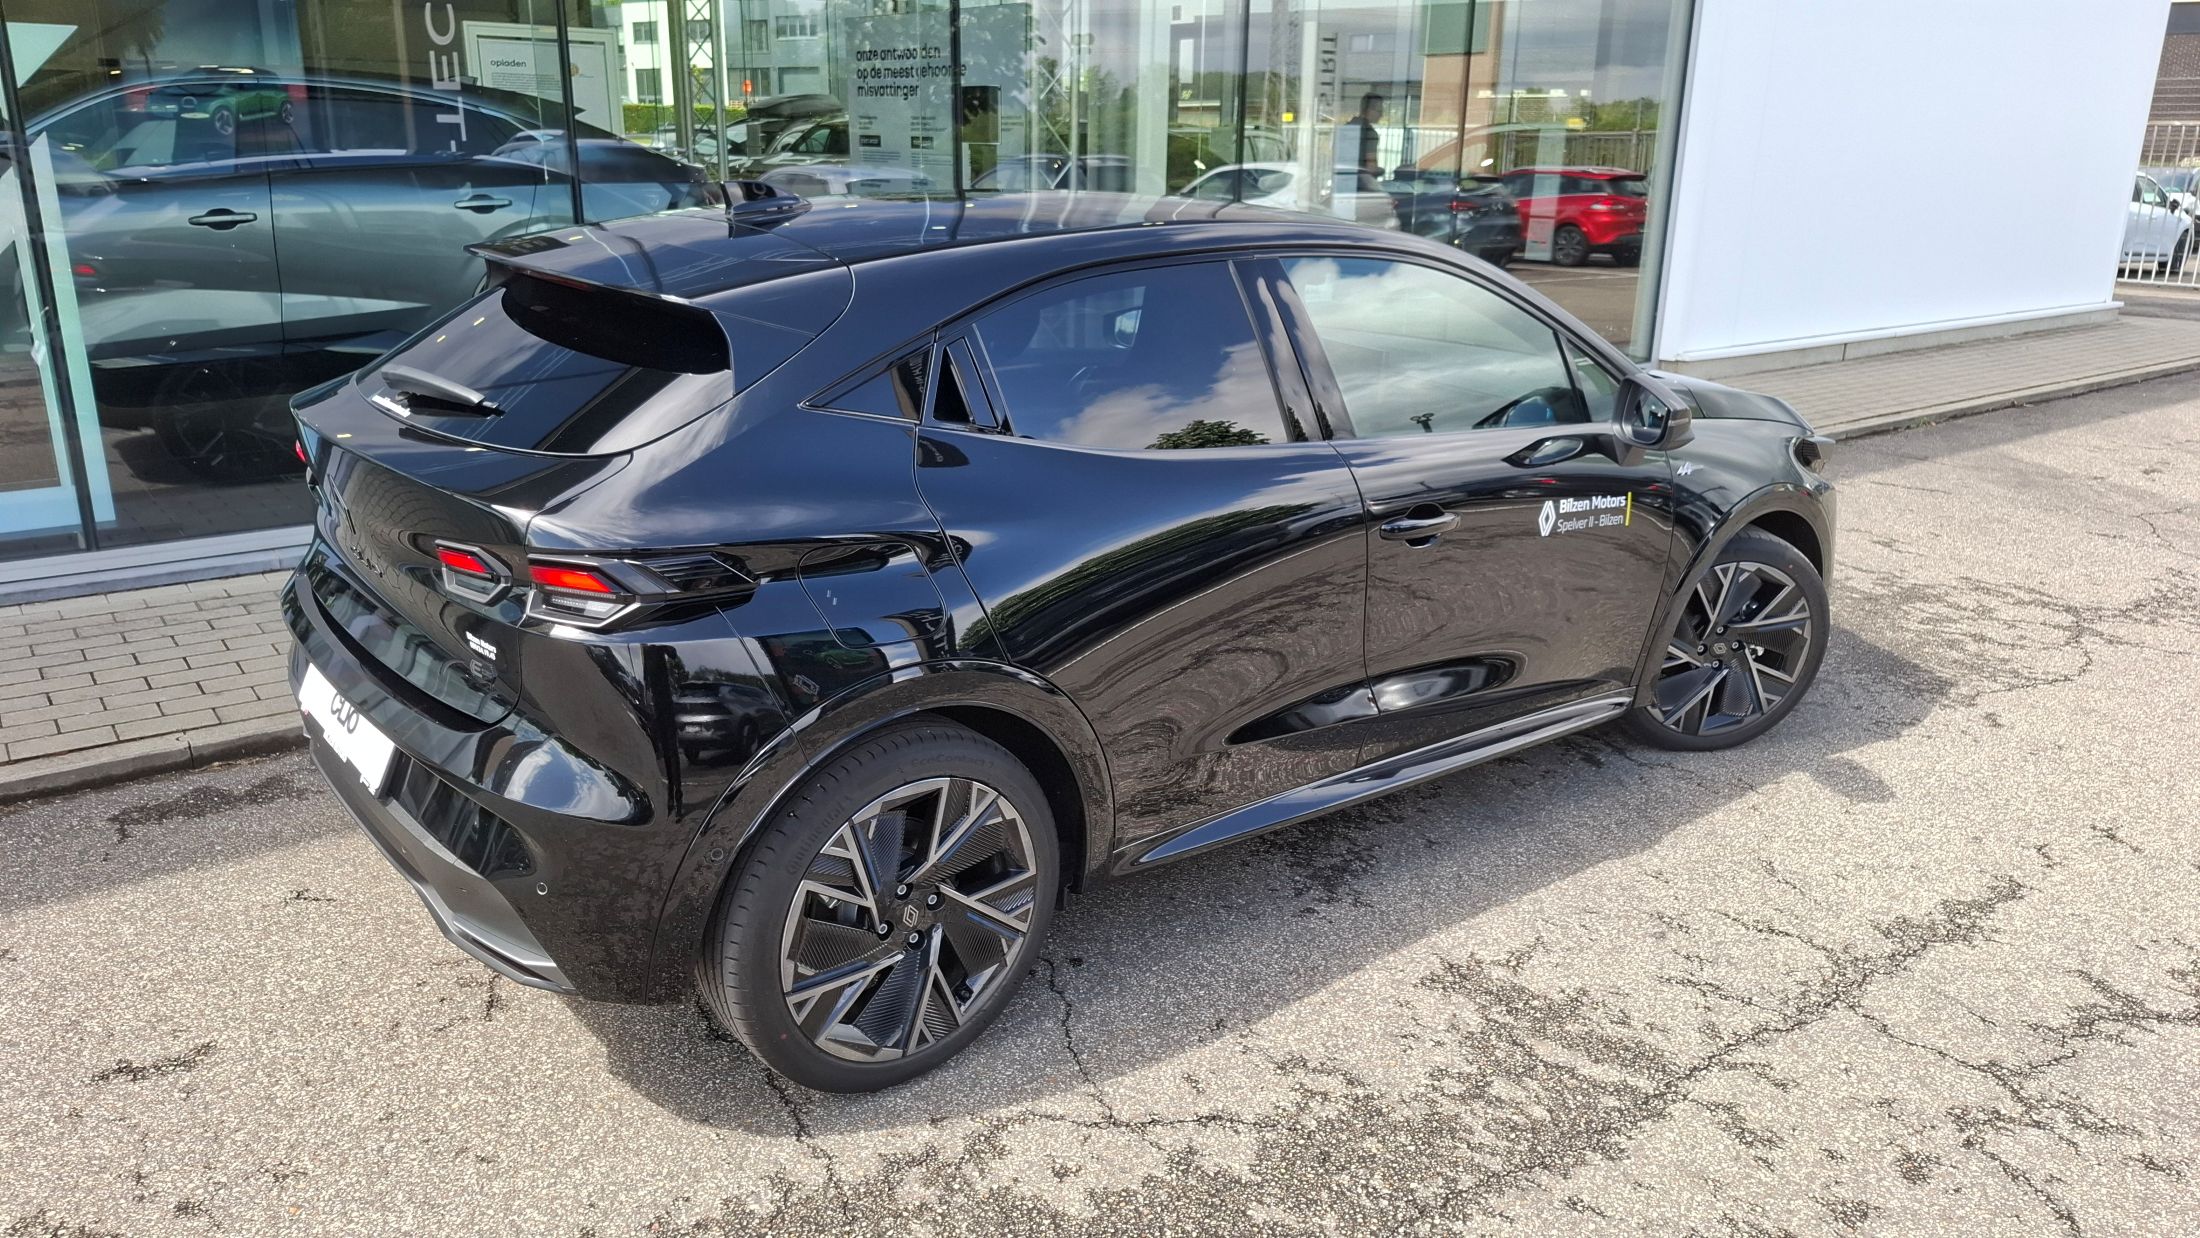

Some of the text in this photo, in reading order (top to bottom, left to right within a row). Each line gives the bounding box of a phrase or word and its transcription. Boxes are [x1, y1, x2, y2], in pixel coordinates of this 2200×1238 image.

[856, 43, 941, 61] onze antwooden
[490, 58, 527, 68] opladen
[857, 62, 967, 82] op de meest ehoore
[1559, 494, 1627, 514] Bilzen Motors
[1557, 517, 1588, 534] Spelver
[1599, 513, 1624, 527] Bilzen
